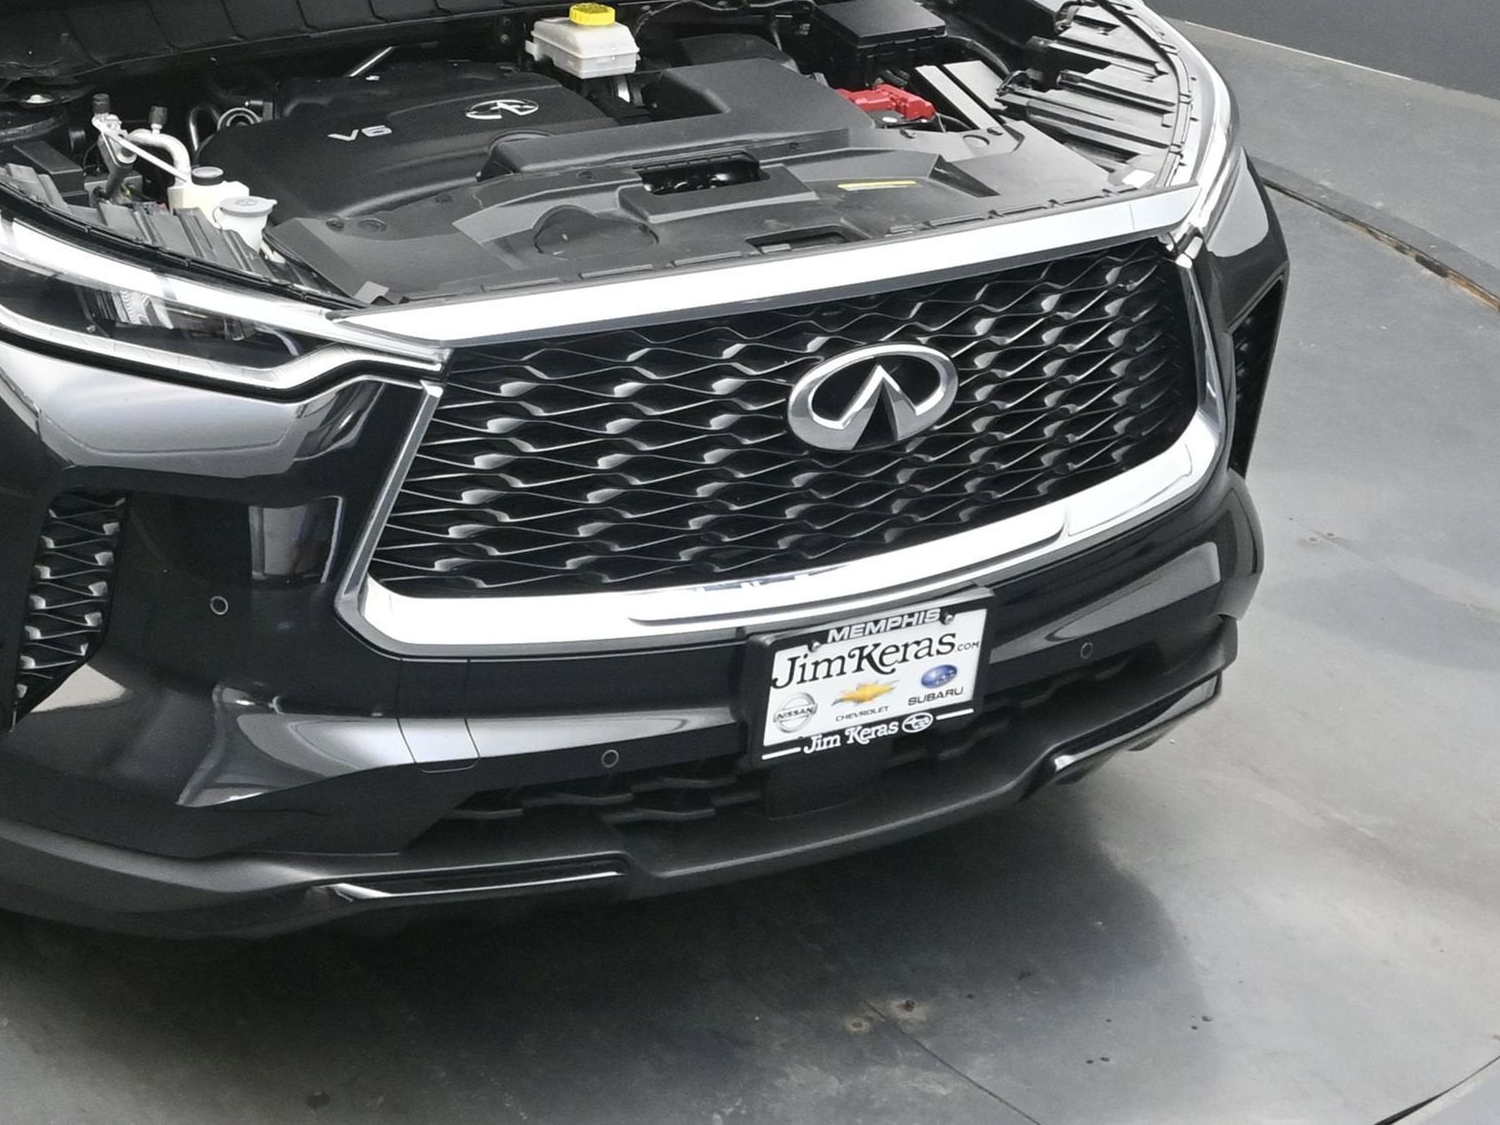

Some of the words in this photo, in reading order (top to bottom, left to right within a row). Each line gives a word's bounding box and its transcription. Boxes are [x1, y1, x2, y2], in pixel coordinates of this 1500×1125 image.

[327, 124, 392, 142] V6
[827, 608, 941, 643] MEMPHIS
[907, 686, 964, 706] SUBARU
[776, 706, 814, 720] NISSAN
[835, 705, 889, 722] CHEVROLET
[803, 733, 842, 754] Jim
[844, 721, 899, 745] Keras
